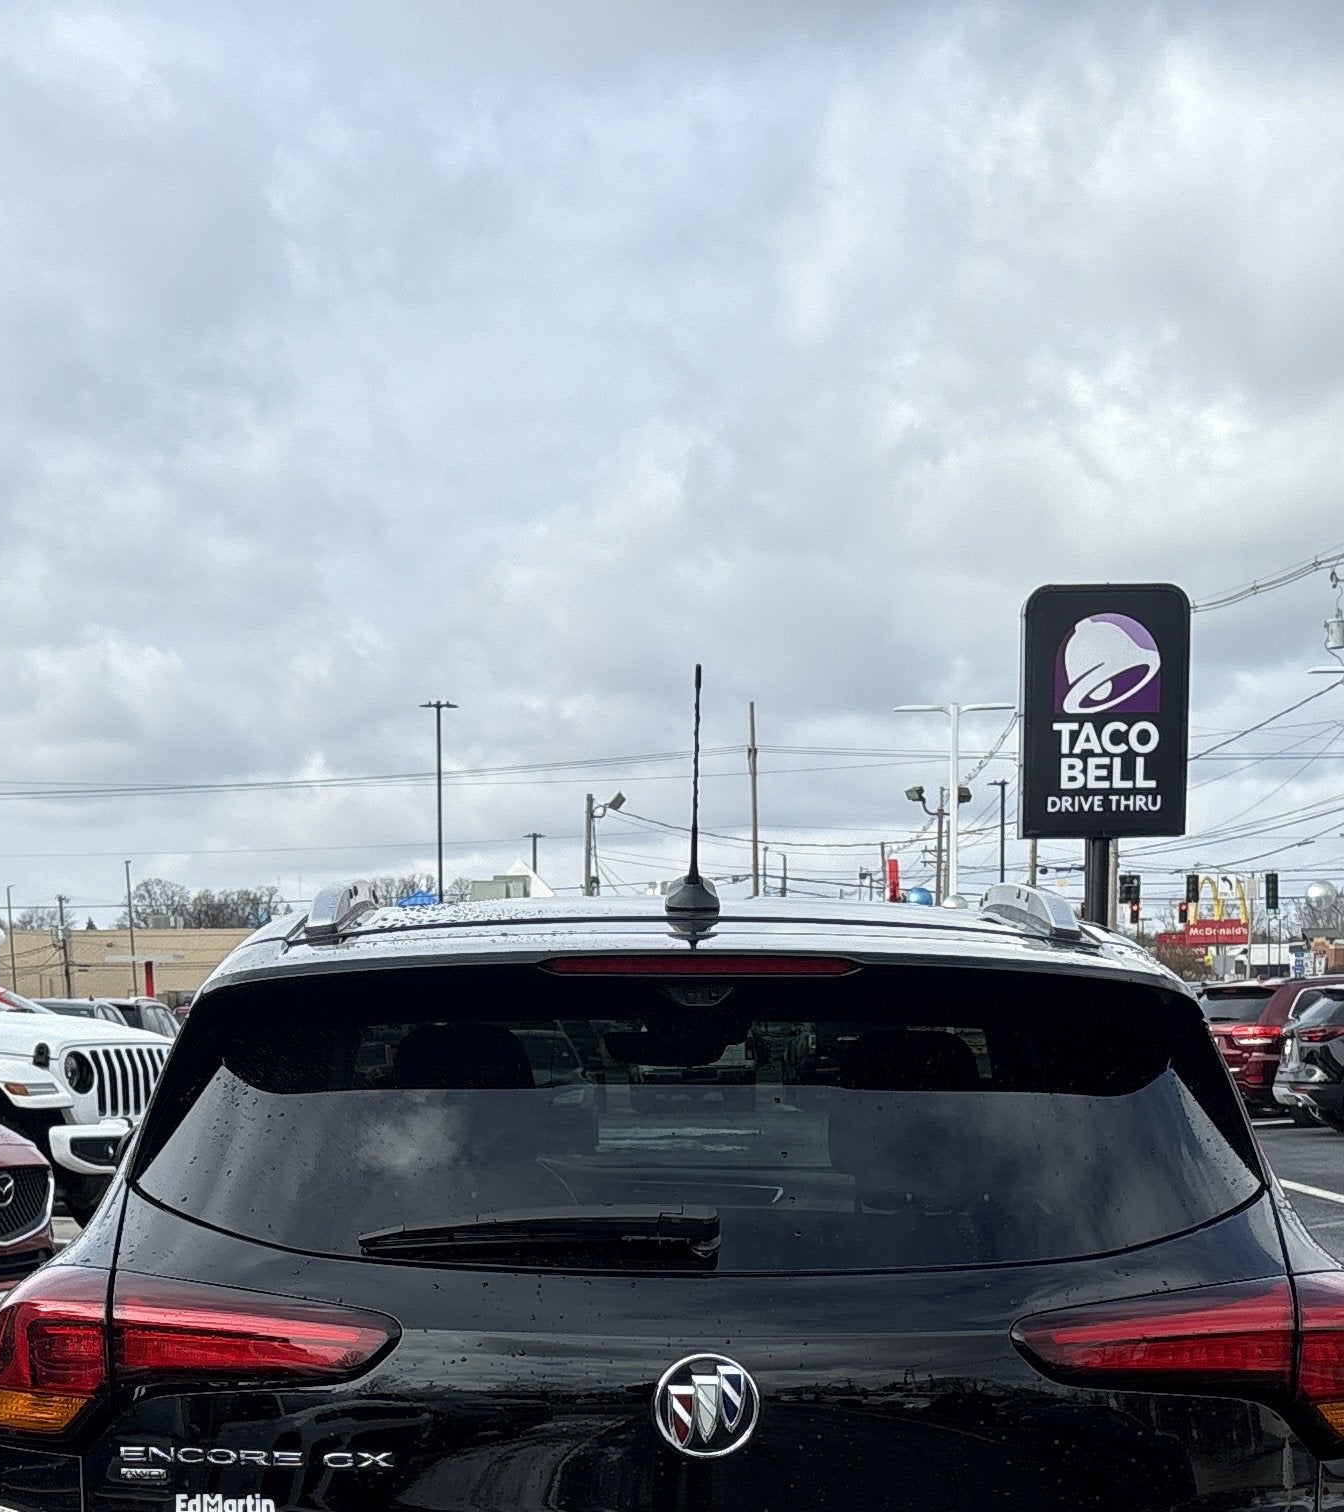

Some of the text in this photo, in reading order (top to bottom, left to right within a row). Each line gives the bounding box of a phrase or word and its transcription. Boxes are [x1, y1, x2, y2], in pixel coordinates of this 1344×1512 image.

[1052, 721, 1160, 754] TACO
[1060, 757, 1157, 789] BELL
[1046, 794, 1162, 813] DRIVE THRU
[119, 1446, 395, 1468] ENCORE GX
